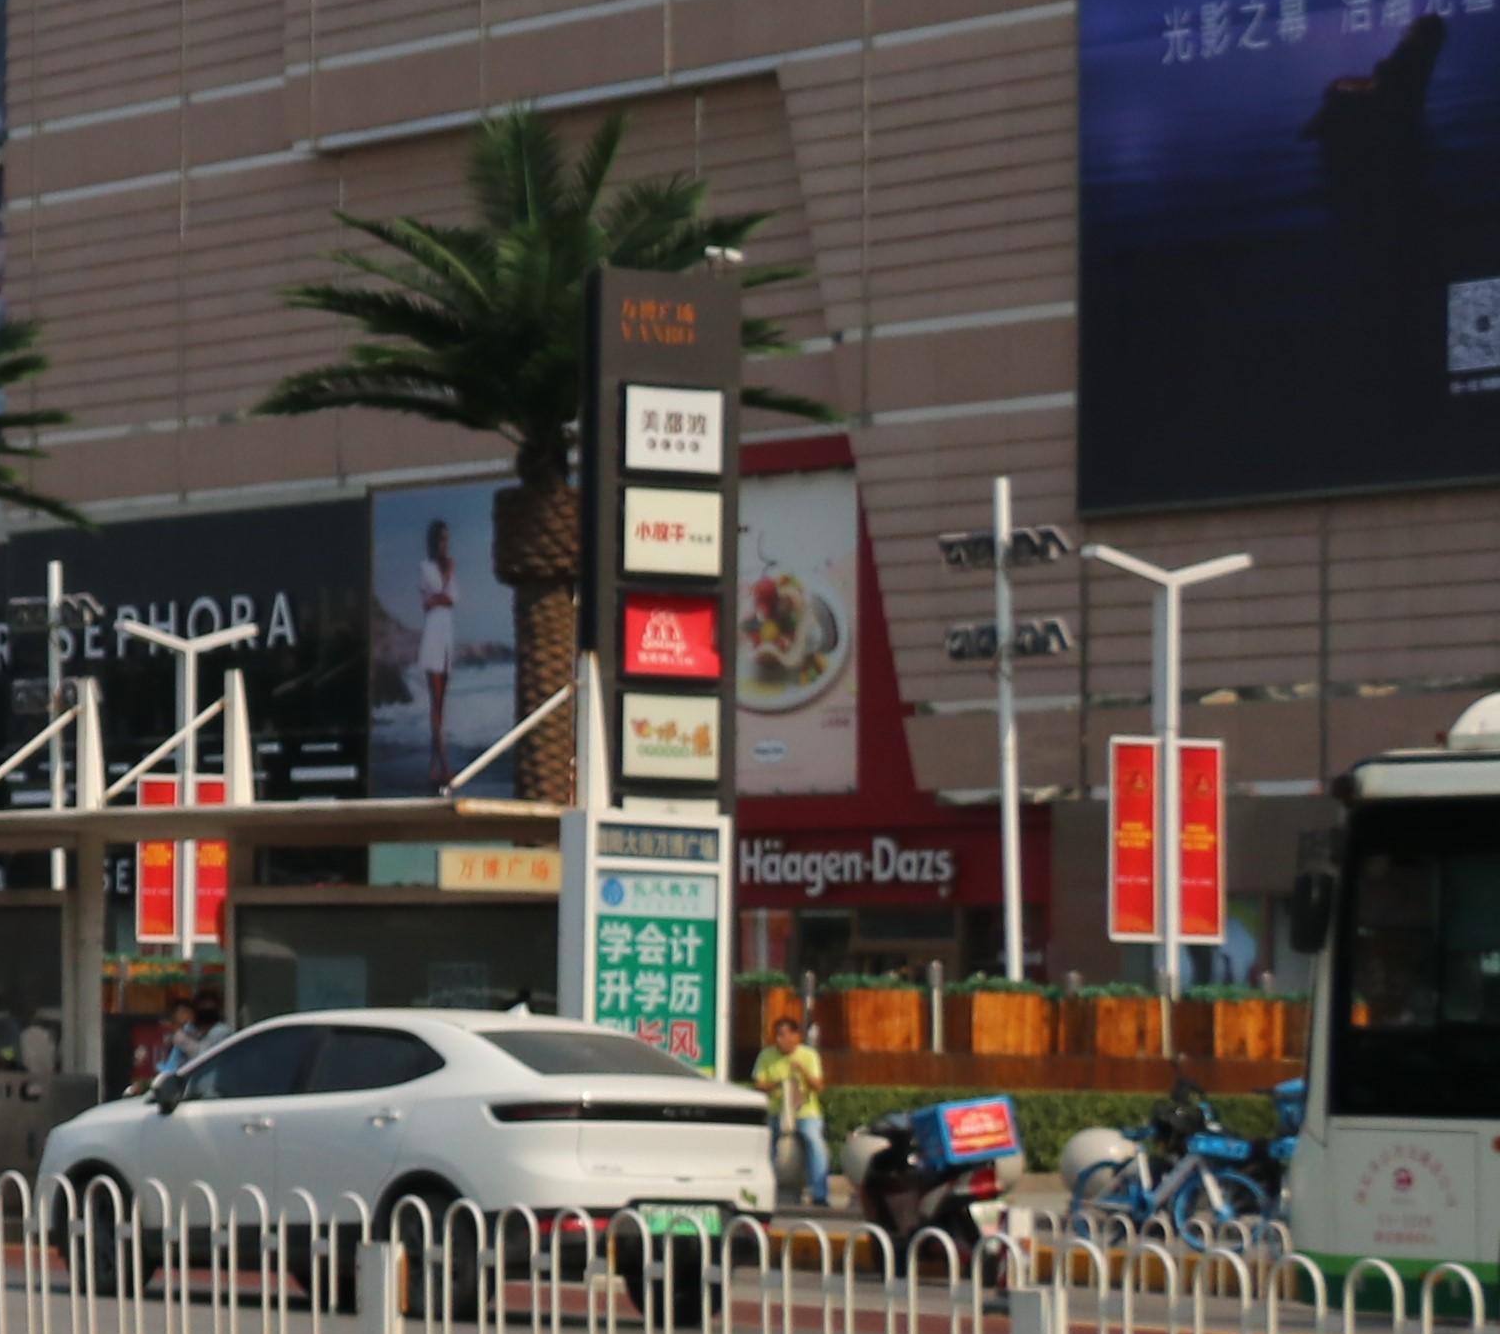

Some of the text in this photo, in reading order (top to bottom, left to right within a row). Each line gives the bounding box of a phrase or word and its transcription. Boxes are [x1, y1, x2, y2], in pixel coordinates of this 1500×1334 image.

[599, 920, 704, 967] 学会计
[599, 970, 703, 1013] 升学历
